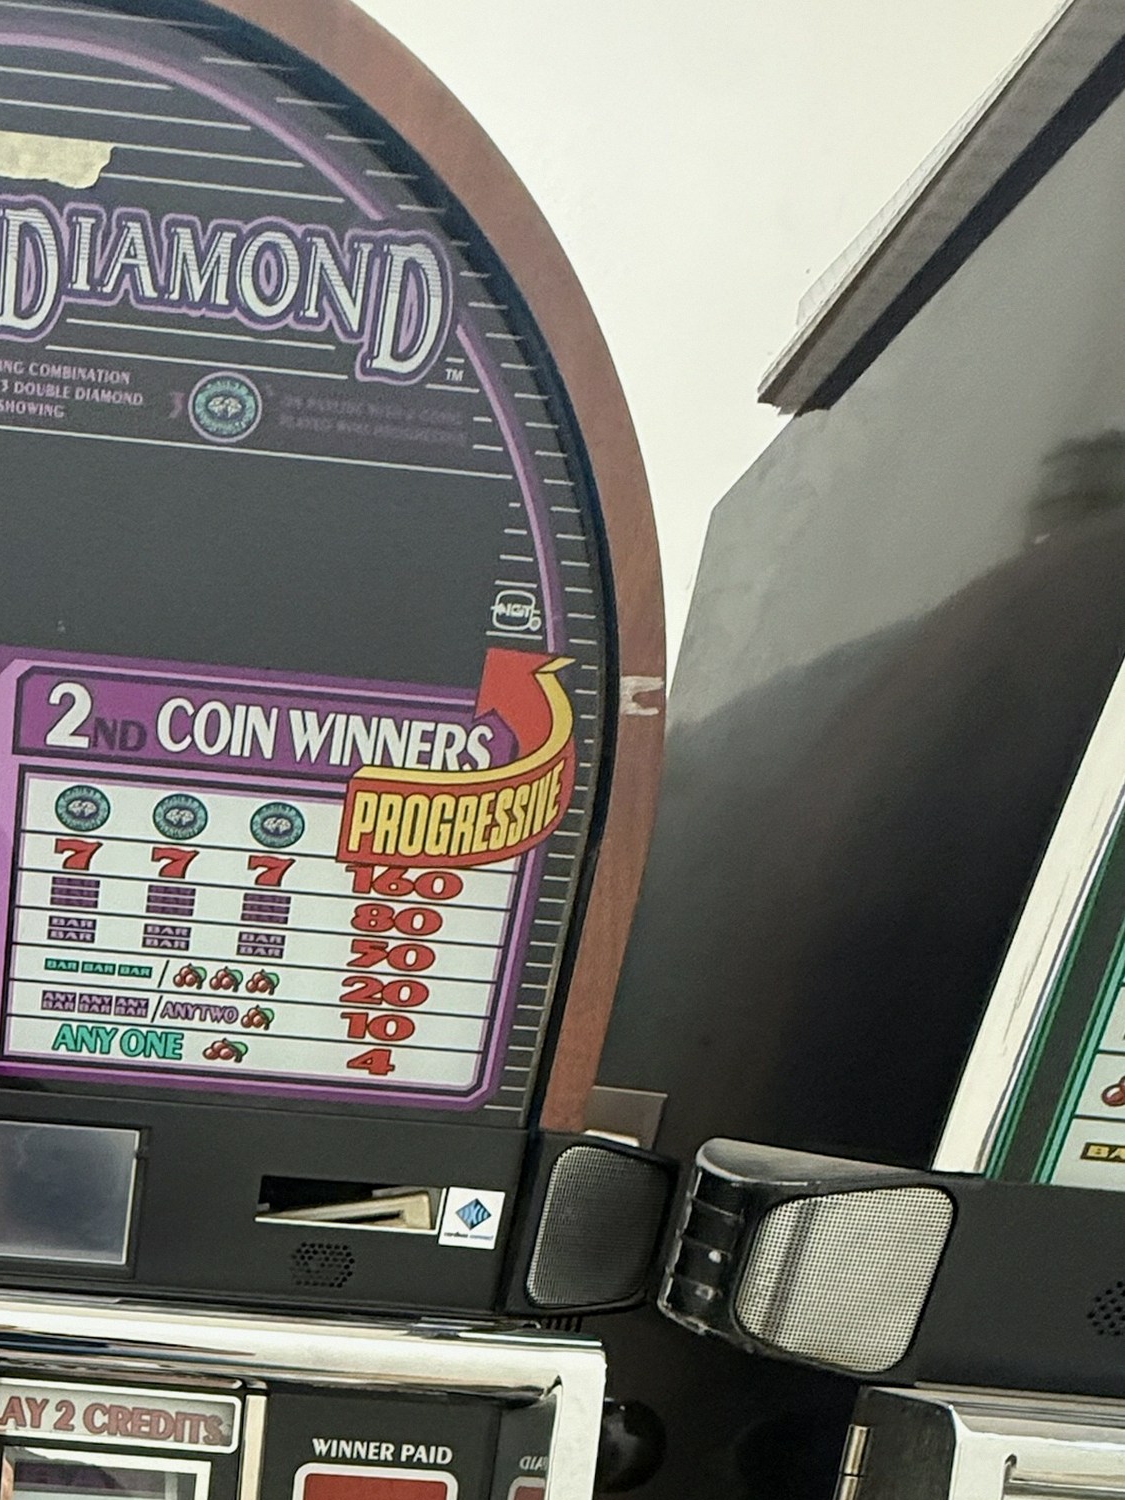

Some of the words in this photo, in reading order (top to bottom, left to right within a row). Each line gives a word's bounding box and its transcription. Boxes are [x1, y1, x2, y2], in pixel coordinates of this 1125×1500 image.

[28, 362, 130, 384] COMBINATION
[14, 382, 70, 399] DOUBLE
[75, 387, 143, 406] DIAMOND
[45, 682, 146, 751] 2ND
[156, 696, 279, 760] COIN
[289, 709, 494, 772] WINNERS
[347, 760, 566, 858] PROGRESSIVE
[54, 838, 103, 871] 7
[151, 847, 199, 879] 7
[247, 855, 296, 887] 7
[345, 863, 464, 900] 160
[351, 902, 443, 936] 80
[346, 941, 435, 973] 50
[339, 976, 429, 1007] 20
[340, 1012, 415, 1042] 10
[52, 1023, 119, 1053] ANY
[120, 1028, 184, 1060] ONE
[347, 1049, 395, 1075] 4
[54, 1400, 75, 1432] 2
[82, 1402, 225, 1447] CREDITS
[312, 1438, 395, 1462] WINNER
[400, 1444, 453, 1465] PAID
